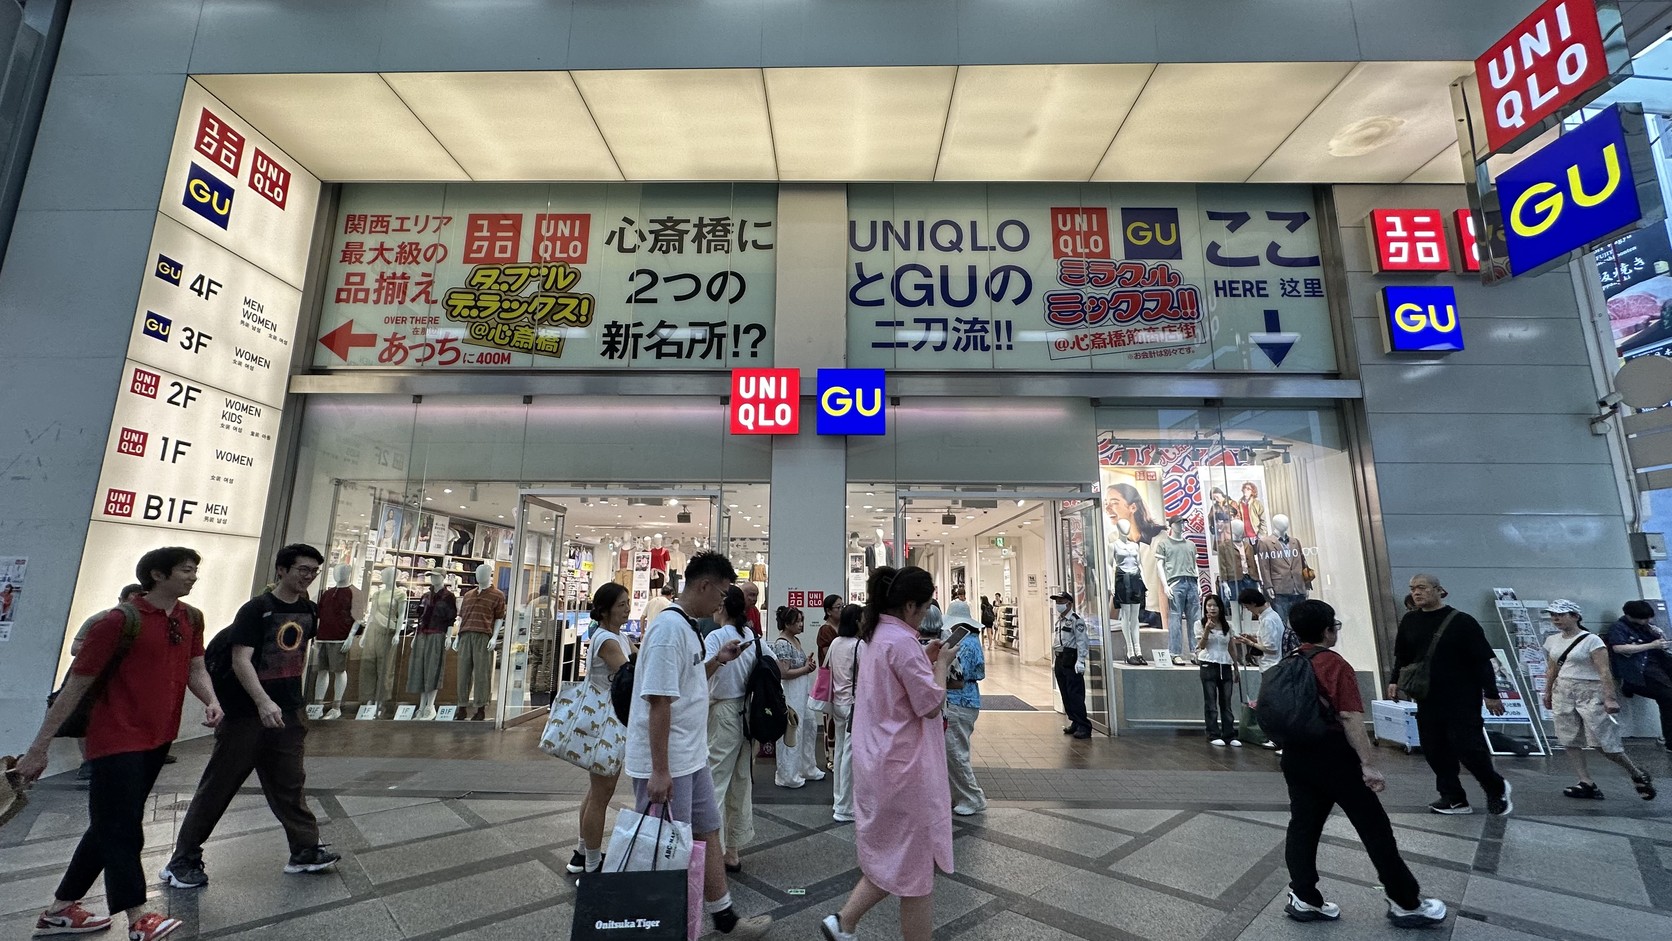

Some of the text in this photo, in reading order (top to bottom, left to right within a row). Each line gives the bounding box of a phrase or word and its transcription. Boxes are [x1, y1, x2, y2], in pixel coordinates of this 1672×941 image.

[1488, 2, 1572, 89] UNI
[1496, 43, 1588, 129] QLO
[256, 155, 285, 186] UNI
[189, 178, 231, 216] GU
[253, 174, 284, 203] QLO
[1510, 143, 1621, 237] GU
[344, 213, 453, 235] 関西エリア
[474, 219, 513, 237] ユニ
[541, 219, 579, 237] UNI
[1057, 213, 1097, 231] UNI
[1126, 221, 1178, 246] GU
[1386, 216, 1435, 237] ユニ
[605, 216, 774, 255] 心斎橋に
[850, 219, 1030, 253] UNIQLO
[1059, 235, 1103, 256] QLO
[1206, 210, 1320, 268] ここ
[340, 241, 448, 265] 最大級の
[469, 241, 512, 258] クロ
[539, 241, 582, 261] QLO
[1389, 242, 1440, 263] クロ
[158, 261, 223, 301] GU 4F
[470, 265, 576, 291] ダブル
[849, 262, 1033, 308] とGUの
[1060, 259, 1180, 287] ミラクル
[335, 270, 439, 305] 品揃え
[625, 268, 746, 305] 2つの
[1214, 277, 1325, 298] HERE 这里
[243, 296, 264, 314] MEN
[446, 292, 594, 323] デラックス!
[1049, 289, 1200, 322] ミックス!!
[242, 308, 277, 333] WOMEN
[384, 316, 440, 325] OVER THERE
[1394, 303, 1456, 333] GU
[145, 317, 213, 354] GU 3F
[470, 322, 565, 354] @心斎橋
[600, 319, 767, 360] 新名所!?
[871, 317, 1014, 352] 二刀流!!
[234, 346, 271, 370] WOMEN
[133, 383, 155, 397] QLO
[136, 371, 156, 385] UNI
[738, 376, 787, 399] UNI
[166, 381, 202, 409] 2F
[225, 397, 262, 418] WOMEN
[821, 386, 882, 417] GU
[221, 410, 243, 425] KIDS
[738, 403, 792, 430] QLO
[120, 441, 143, 455] QLO
[123, 430, 143, 444] UNI
[159, 436, 191, 464] 1F
[215, 449, 254, 467] WOMEN
[107, 502, 131, 516] QLO
[109, 491, 131, 502] UNI
[143, 494, 198, 524] B1F
[205, 503, 228, 516] MEN
[595, 918, 661, 930] Onitsuka Tiger
